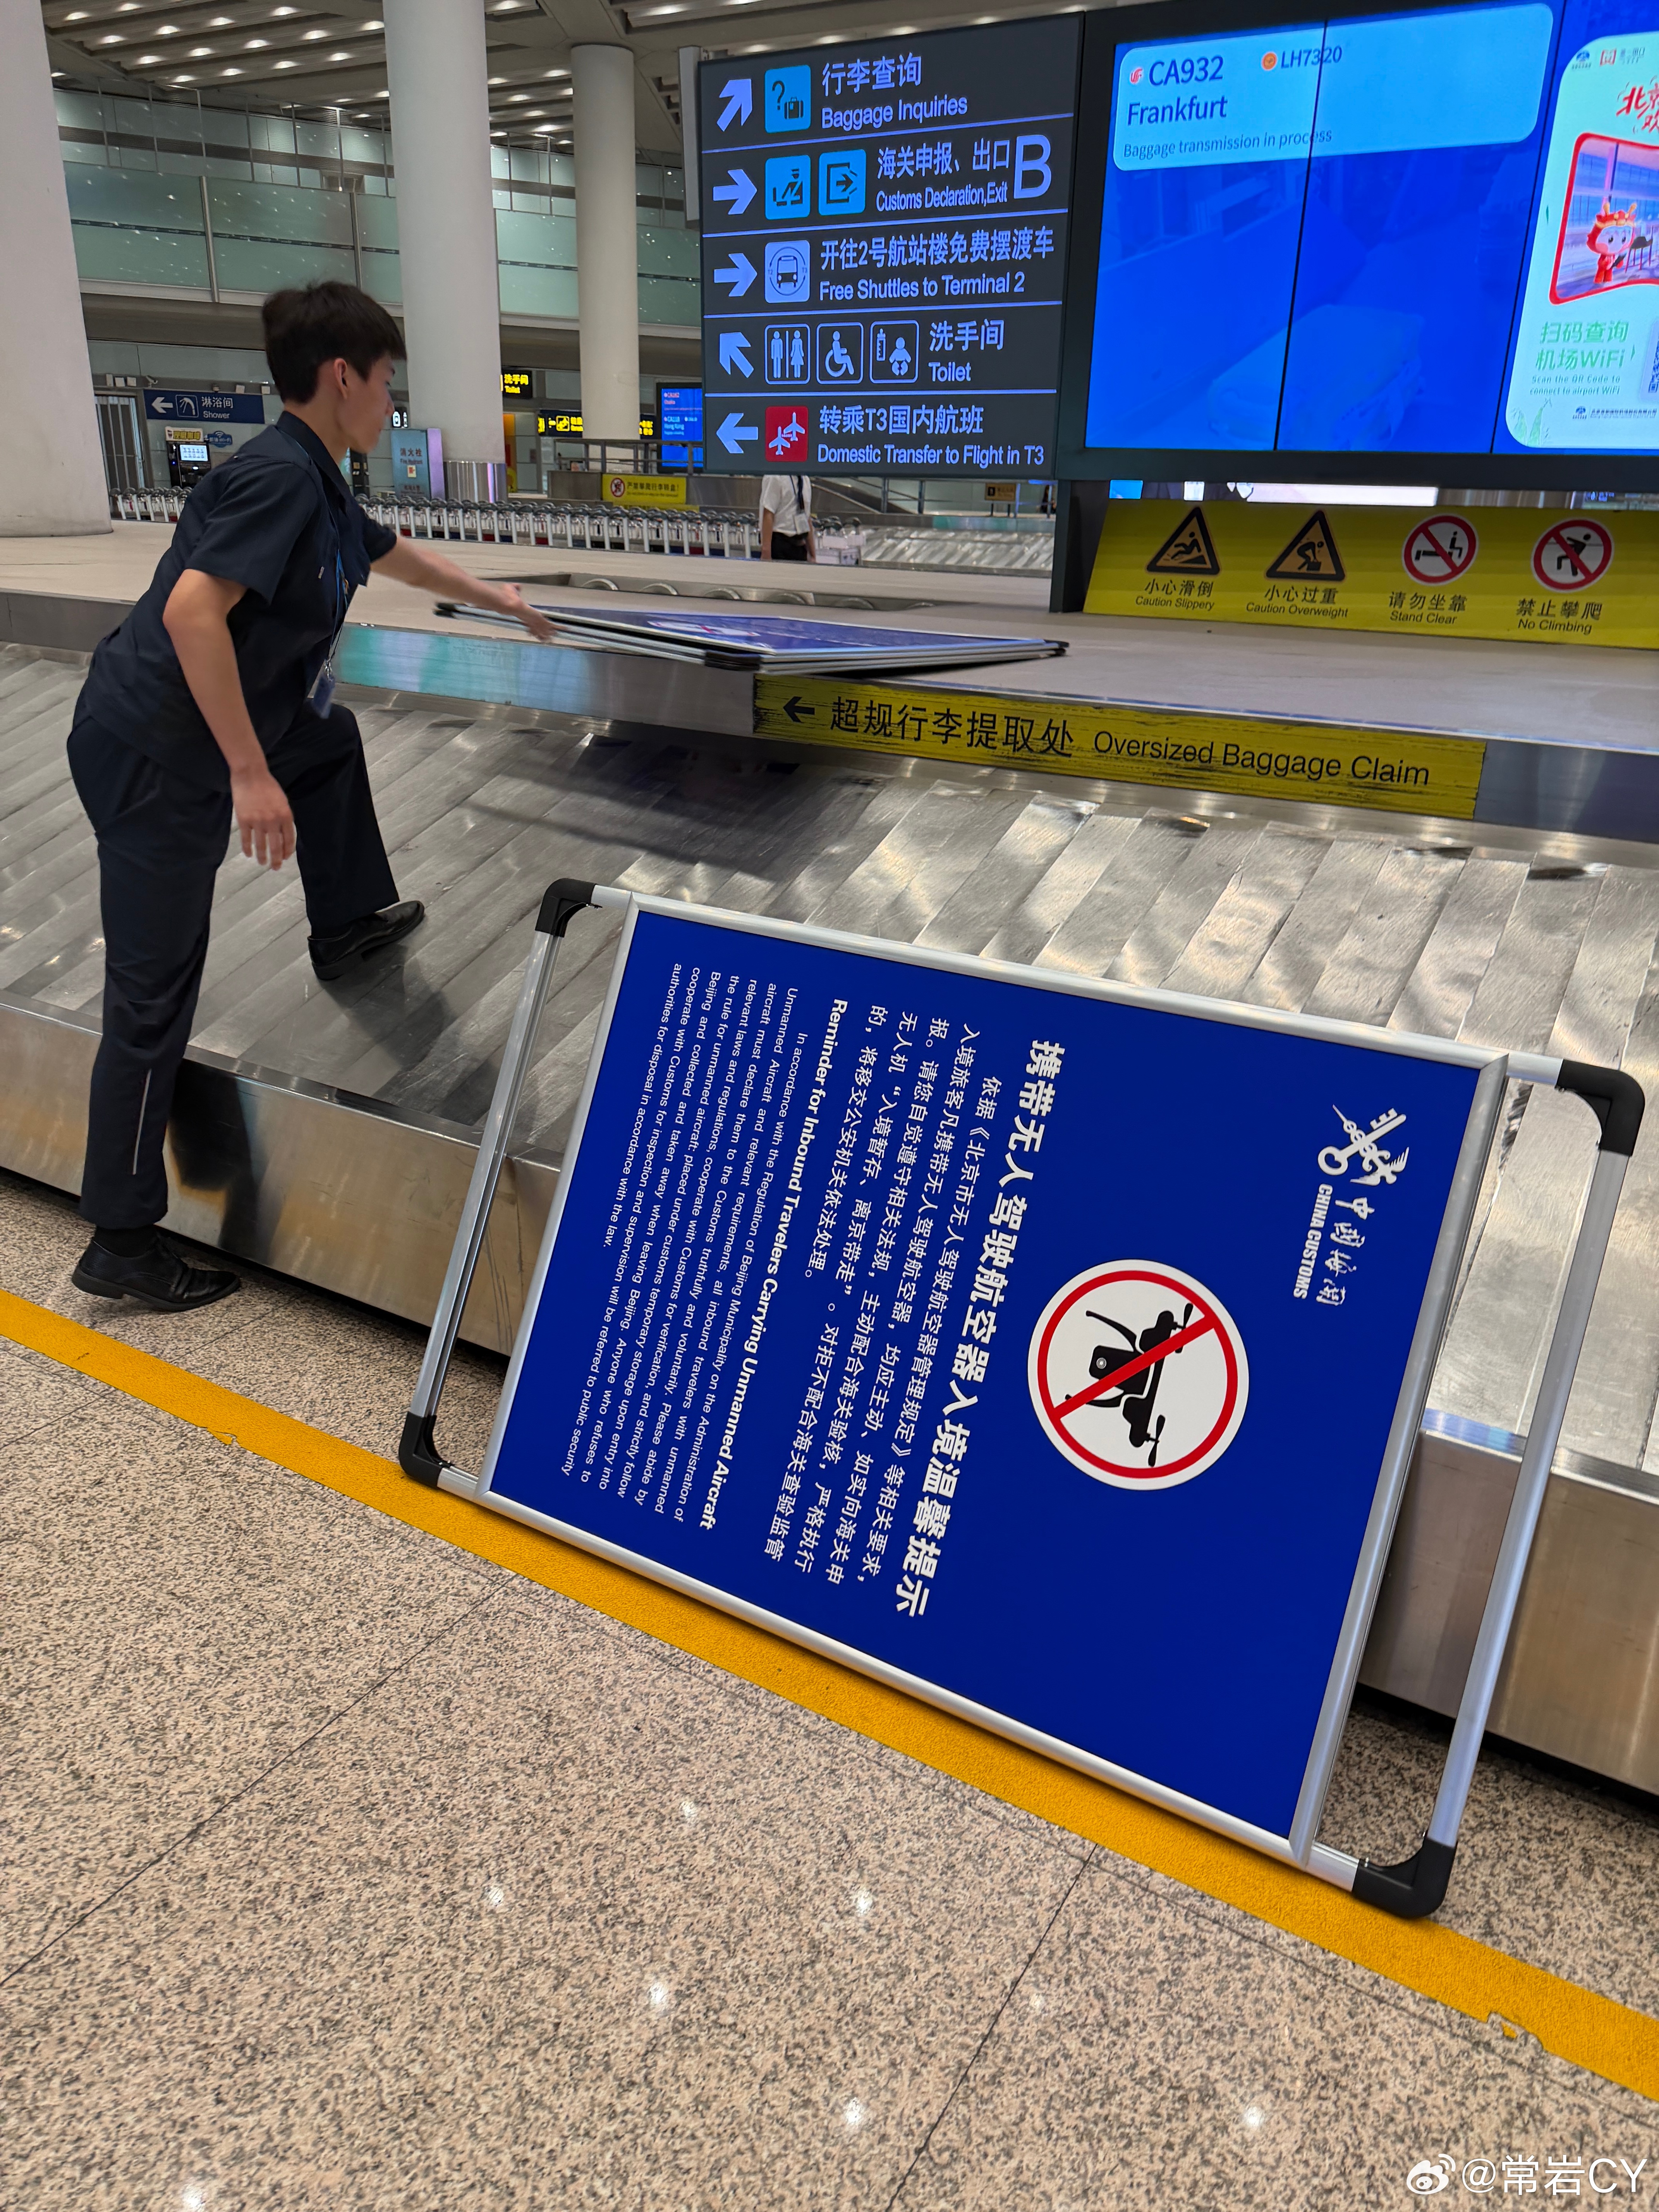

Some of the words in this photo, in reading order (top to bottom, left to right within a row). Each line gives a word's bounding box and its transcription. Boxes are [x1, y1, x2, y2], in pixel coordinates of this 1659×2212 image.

[822, 53, 921, 96] 行李查询
[1149, 56, 1223, 86] CA932
[1281, 46, 1342, 69] LH7320
[822, 106, 893, 131] Baggage
[899, 94, 967, 123] Inquiries
[1128, 96, 1228, 125] Frankfurt
[1123, 143, 1175, 160] Baggage
[1180, 134, 1259, 154] transmission
[1264, 132, 1275, 147] in
[1014, 135, 1051, 199] B
[876, 191, 922, 211] Customs
[821, 226, 1054, 270] 开往2号航站楼免费摆渡车
[820, 281, 853, 301] Free
[857, 278, 919, 299] Shuttles
[923, 277, 938, 296] to
[941, 272, 1010, 295] Terminal
[1014, 271, 1025, 292] 2
[929, 319, 1004, 351] 洗手间
[1540, 321, 1629, 344] 扫码查询
[928, 362, 971, 381] Toilet
[1535, 348, 1625, 371] 机场WiFi
[202, 396, 233, 408] 淋浴间
[820, 405, 984, 434] 转乘T3国内航班
[818, 444, 881, 463] Domestic
[884, 445, 943, 464] Transfer
[945, 446, 959, 464] to
[963, 445, 1003, 469] Flight
[1007, 445, 1020, 464] in
[1024, 445, 1044, 465] T3
[1136, 596, 1171, 606] Caution
[1175, 598, 1214, 611] Slippery
[1145, 579, 1213, 597] 小心滑倒
[1265, 585, 1338, 604] 小心过重
[1389, 591, 1467, 612] 请勿坐靠
[1247, 603, 1285, 613] Caution
[1289, 605, 1348, 618] Overweight
[1390, 611, 1423, 622] Stand
[1427, 613, 1457, 624] Clear
[1517, 599, 1602, 620] 禁止攀爬
[1518, 619, 1535, 629] No
[1540, 621, 1592, 635] Climbing
[830, 696, 1074, 759] 超规行李提取处
[1094, 731, 1214, 764] Oversized
[1223, 744, 1341, 780] Baggage
[1352, 756, 1429, 786] Claim
[661, 963, 682, 1023] authorities
[680, 967, 700, 1025] cooperate
[739, 979, 757, 1027] relevant
[760, 983, 777, 1025] aircraft
[656, 1026, 668, 1042] for
[773, 988, 798, 1054] Unmanned
[673, 1029, 685, 1052] with
[732, 1030, 747, 1056] laws
[751, 1029, 765, 1059] must
[797, 1033, 808, 1044] In
[815, 999, 848, 1086] Reminder
[644, 1044, 663, 1092] disposal
[660, 1056, 680, 1106] Customs
[725, 1060, 737, 1083] and
[761, 1059, 780, 1103] Aircraft
[779, 1048, 802, 1117] accordance
[641, 1094, 651, 1105] in
[740, 1064, 758, 1108] declare
[808, 1088, 826, 1115] for
[655, 1110, 667, 1126] for
[706, 1085, 731, 1152] regulations,
[731, 1113, 746, 1143] them
[754, 1108, 766, 1132] and
[772, 1121, 784, 1145] with
[623, 1108, 646, 1175] accordance
[727, 1149, 737, 1160] to
[788, 1116, 819, 1192] Inbound
[639, 1129, 662, 1187] inspection
[740, 1138, 759, 1186] relevant
[766, 1149, 779, 1168] the
[616, 1178, 628, 1200] with
[692, 1157, 713, 1216] cooperate
[720, 1166, 733, 1185] the
[610, 1204, 622, 1222] the
[632, 1190, 644, 1213] and
[706, 1190, 727, 1243] Customs
[749, 1171, 774, 1236] Regulation
[1310, 1184, 1333, 1228] CHINA
[603, 1225, 618, 1247] law.
[685, 1220, 697, 1243] with
[716, 1192, 745, 1272] requirements,
[745, 1240, 754, 1253] of
[767, 1195, 800, 1274] Travelers
[615, 1216, 637, 1282] supervision
[1293, 1229, 1322, 1299] CUSTOMS
[670, 1247, 692, 1299] Customs
[689, 1248, 712, 1300] truthfully
[713, 1280, 723, 1295] all
[731, 1255, 752, 1296] Beijing
[608, 1286, 620, 1305] will
[665, 1303, 677, 1320] for
[604, 1307, 616, 1322] be
[684, 1304, 696, 1328] and
[698, 1301, 720, 1351] inbound
[744, 1278, 778, 1353] Carrying
[896, 1040, 1065, 1617] 携带无人驾驶航空器入境温馨提示
[591, 1326, 609, 1373] referred
[712, 1299, 741, 1371] Municipality
[645, 1323, 670, 1388] verification,
[664, 1333, 688, 1395] voluntarily.
[587, 1376, 597, 1387] to
[683, 1356, 704, 1408] travelers
[709, 1374, 719, 1389] on
[576, 1389, 591, 1426] public
[639, 1393, 651, 1417] and
[703, 1393, 716, 1413] the
[719, 1358, 758, 1460] Unmanned
[626, 1419, 644, 1459] strictly
[652, 1403, 672, 1444] Please
[674, 1416, 687, 1440] with
[561, 1429, 581, 1476] security
[642, 1449, 657, 1484] abide
[678, 1416, 709, 1504] Administration
[617, 1462, 635, 1498] follow
[654, 1447, 679, 1514] unmanned
[699, 1460, 729, 1530] Aircraft
[634, 1489, 648, 1506] by
[674, 1508, 684, 1522] of
